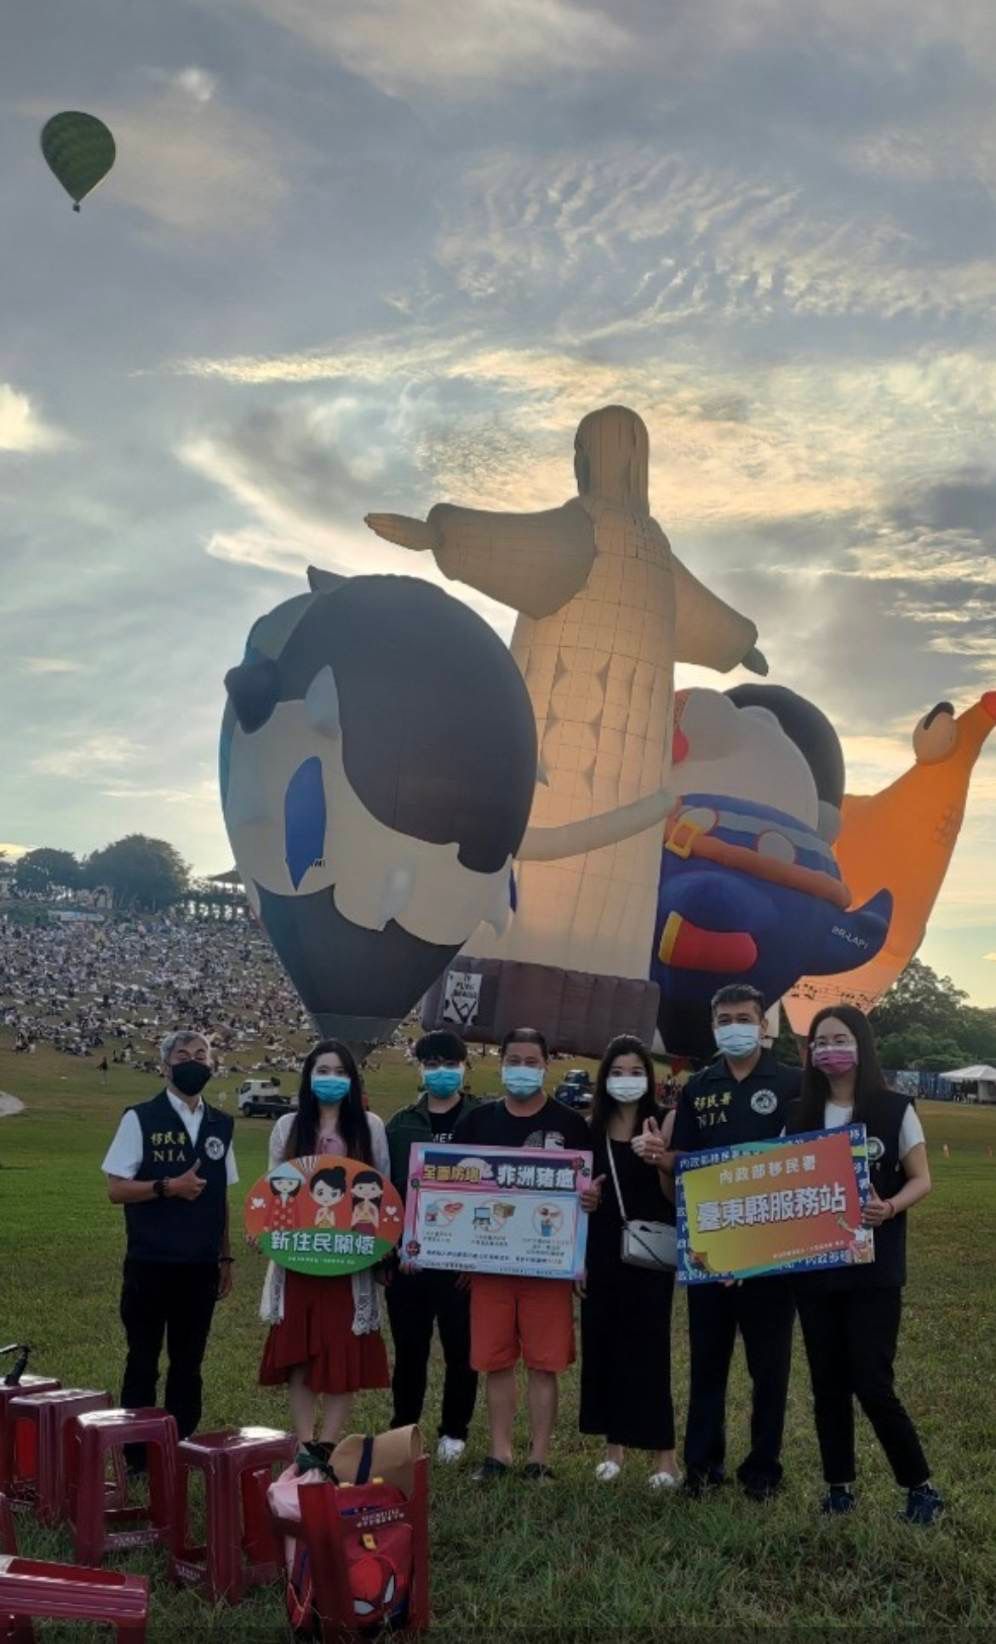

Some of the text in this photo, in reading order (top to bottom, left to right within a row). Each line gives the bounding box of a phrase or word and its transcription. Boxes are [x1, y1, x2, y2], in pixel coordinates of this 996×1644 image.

[153, 1149, 187, 1163] NIA
[497, 1164, 576, 1190] 非洲豬瘟
[696, 1181, 848, 1234] 臺東縣服務站
[271, 1231, 376, 1256] 新住民關懷
